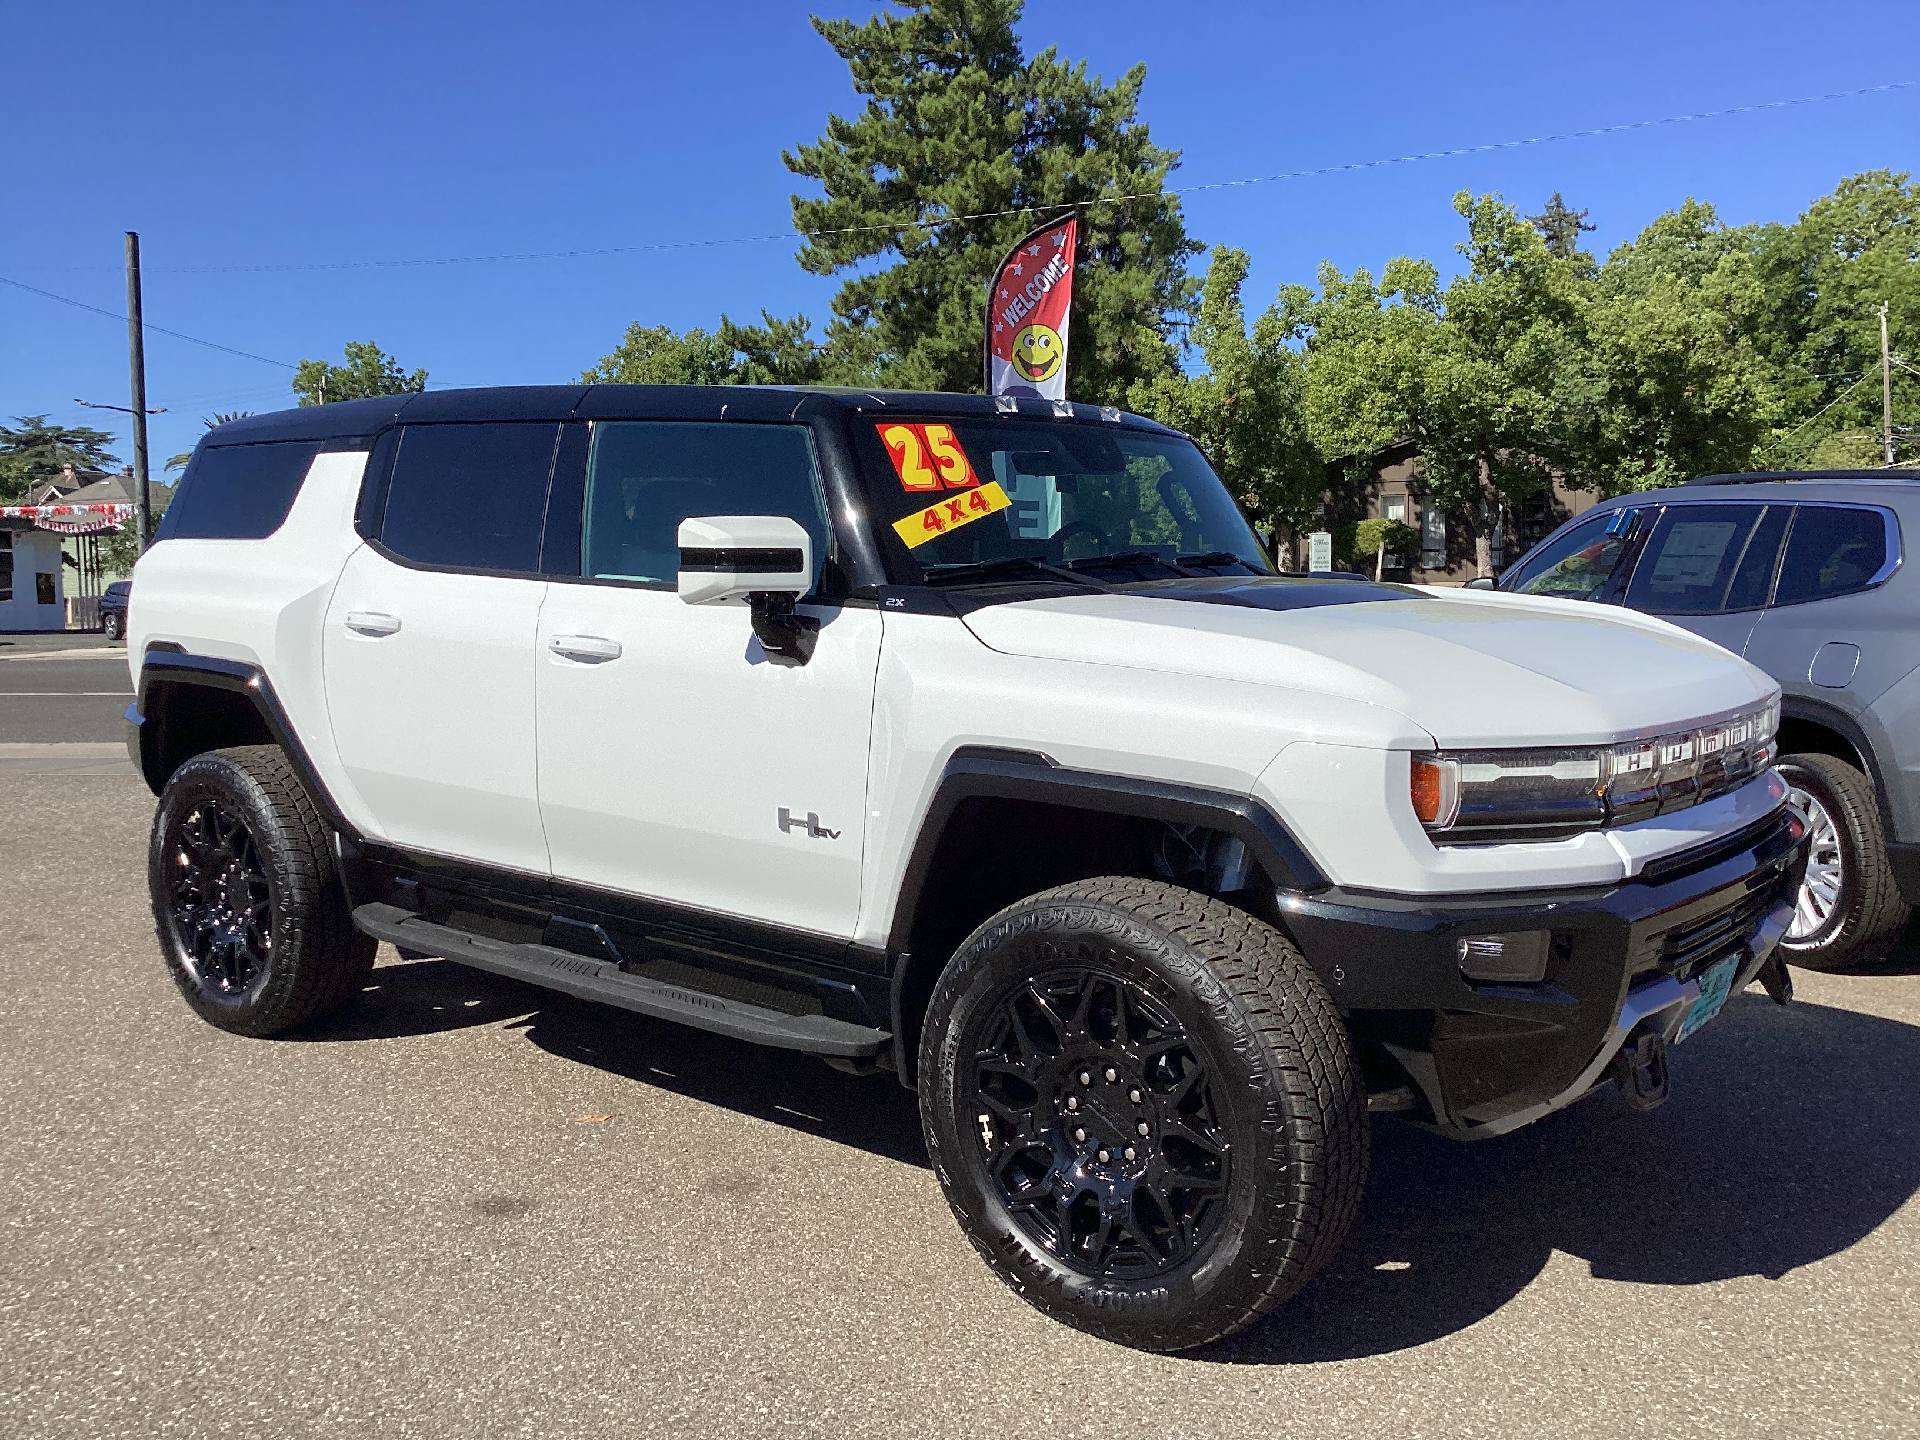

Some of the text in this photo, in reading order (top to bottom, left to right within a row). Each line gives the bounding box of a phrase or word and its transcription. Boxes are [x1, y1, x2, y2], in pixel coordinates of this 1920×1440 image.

[1002, 252, 1070, 328] WELCOME
[884, 425, 971, 489] 25
[923, 490, 990, 532] 4X4
